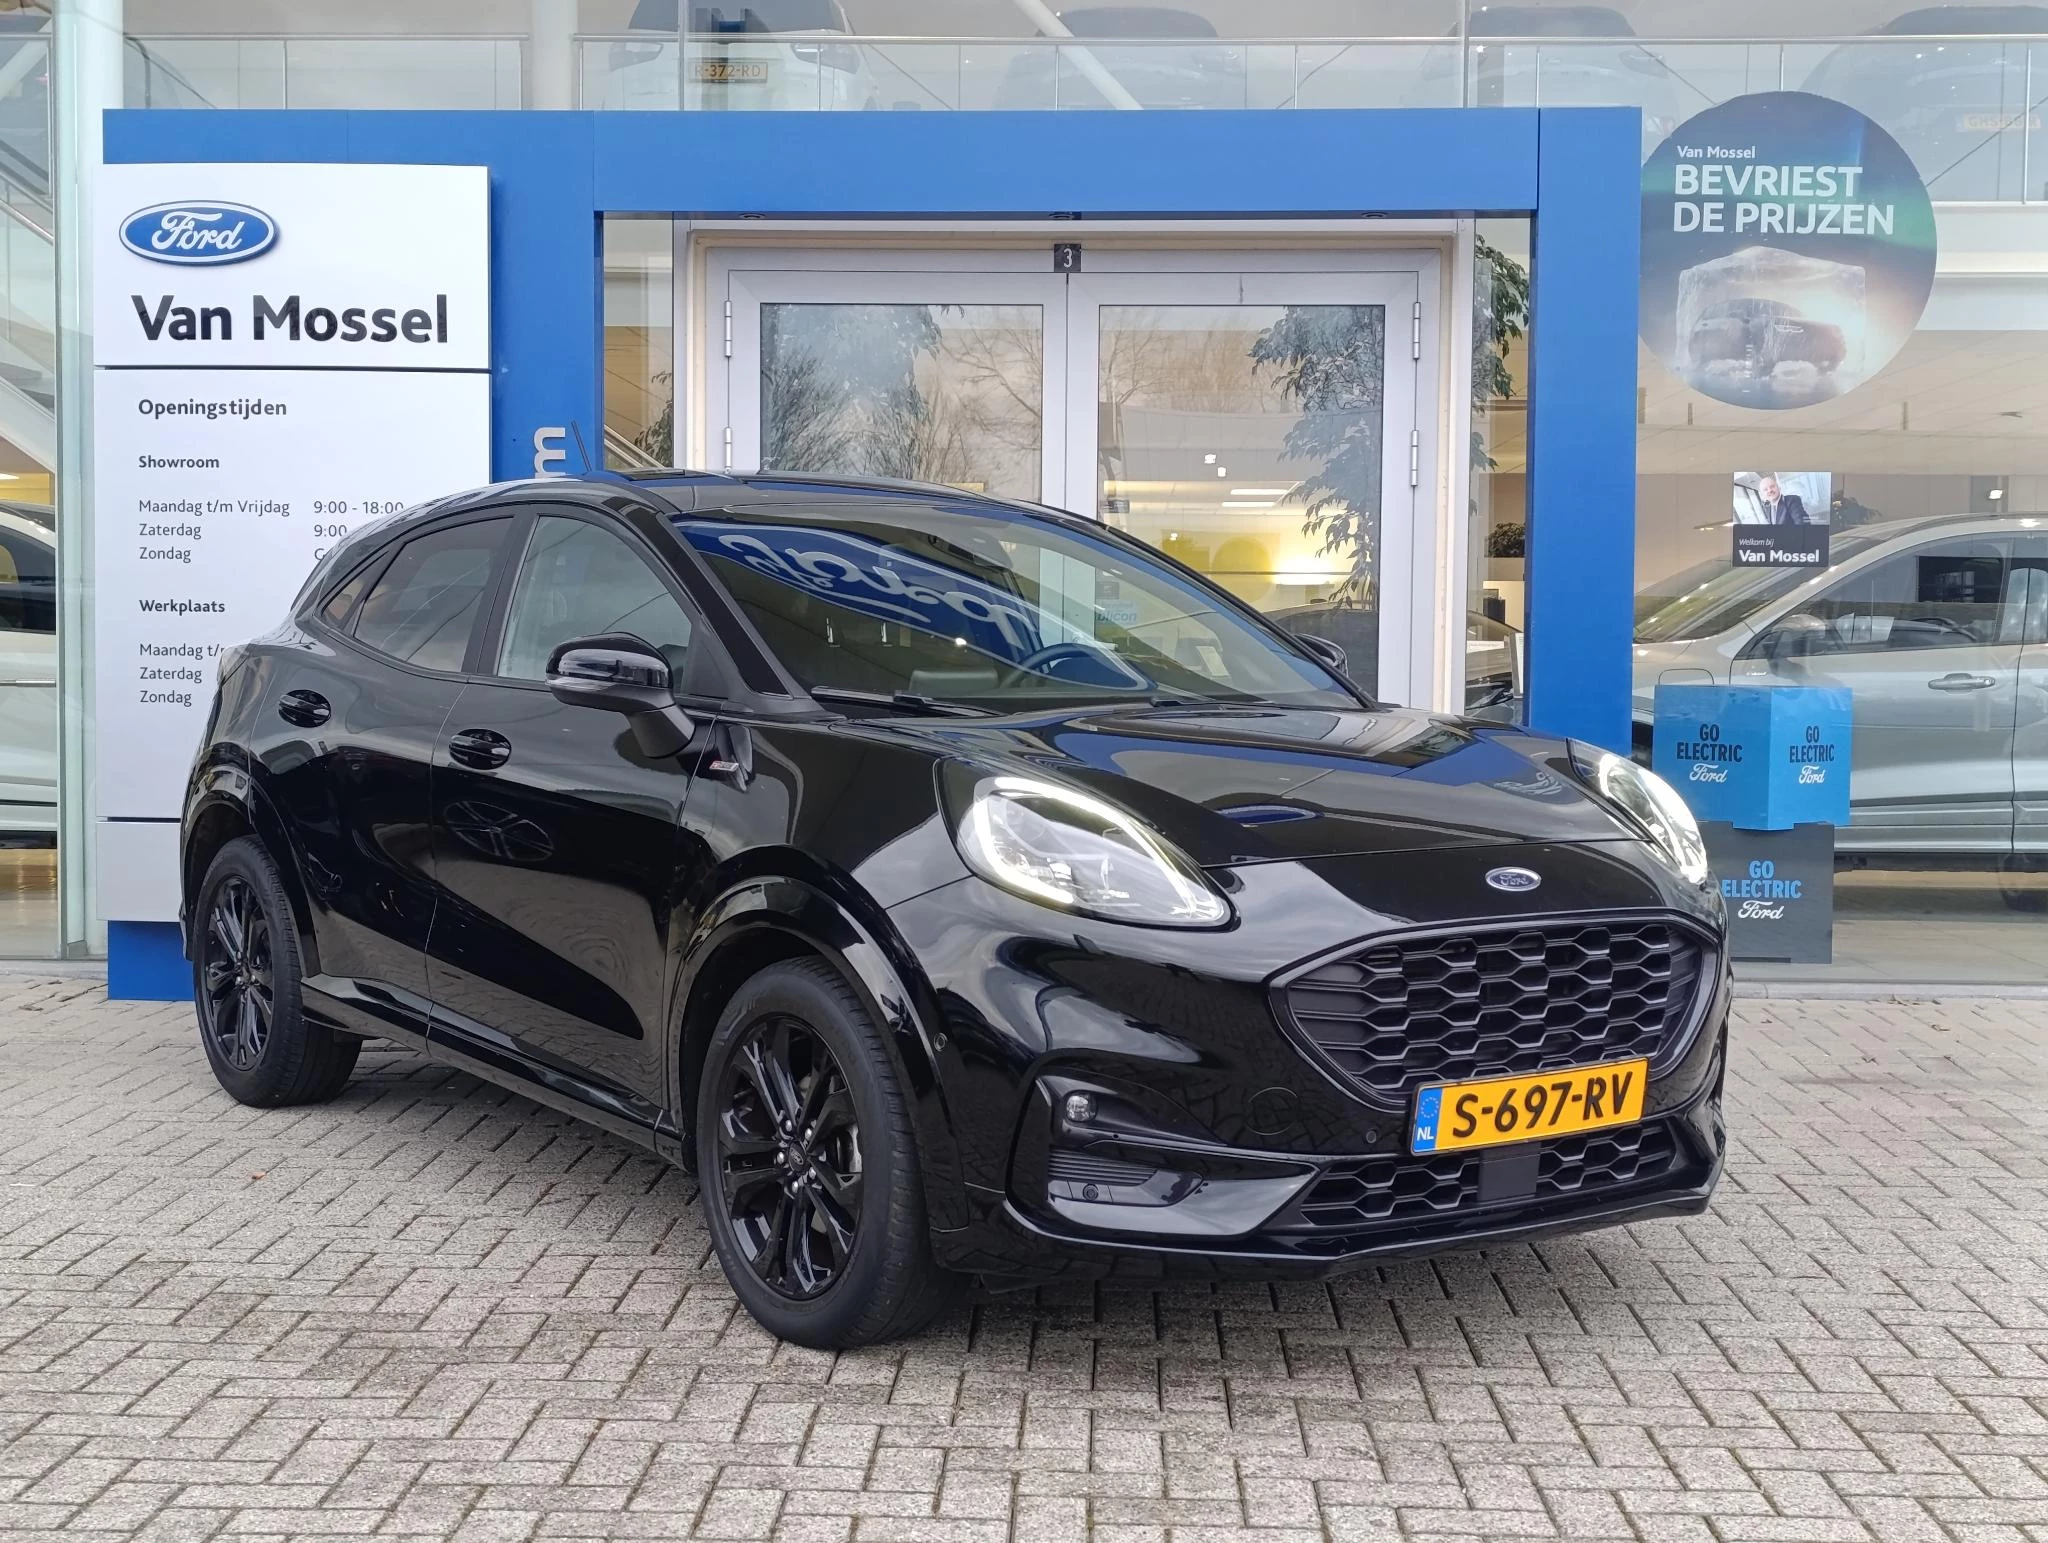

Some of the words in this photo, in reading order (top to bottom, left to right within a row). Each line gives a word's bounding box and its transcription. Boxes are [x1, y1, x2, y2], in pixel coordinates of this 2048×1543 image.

[1677, 145, 1703, 158] Van
[1707, 145, 1756, 159] Mossel
[1674, 163, 1863, 198] BEVRIEST
[1673, 201, 1725, 233] DE
[1735, 203, 1894, 235] PRIJZEN
[151, 210, 246, 251] Ford
[1063, 248, 1073, 268] 3
[130, 294, 232, 341] Van
[253, 294, 448, 344] Mossel
[138, 398, 287, 420] Openingstijden
[138, 455, 220, 469] Showroom
[139, 499, 202, 517] Maandag
[206, 499, 233, 514] t/m
[237, 499, 290, 517] Vrijdag
[313, 500, 347, 514] 9:00
[139, 523, 202, 540] Zaterdag
[313, 524, 347, 537] 9:00
[1738, 538, 1765, 546] Welkom
[1765, 538, 1775, 548] bij
[139, 546, 192, 563] Zondag
[1738, 549, 1766, 562] Van
[1769, 548, 1820, 563] Mossel
[139, 599, 226, 616] Werkplaats
[139, 643, 203, 660] Maandag
[139, 667, 203, 684] Zaterdag
[140, 690, 192, 707] Zondag
[1700, 723, 1720, 742] GO
[1805, 725, 1820, 744] GO
[1676, 742, 1743, 763] ELECTRIC
[1789, 744, 1835, 763] ELECTRIC
[1689, 763, 1727, 783] Ford
[1798, 765, 1825, 784] Ford
[1749, 860, 1775, 880] GO
[1721, 879, 1803, 899] ELECTRIC
[1738, 900, 1784, 920] Ford
[1452, 1071, 1634, 1138] S-697-RV
[1416, 1126, 1435, 1141] NL
